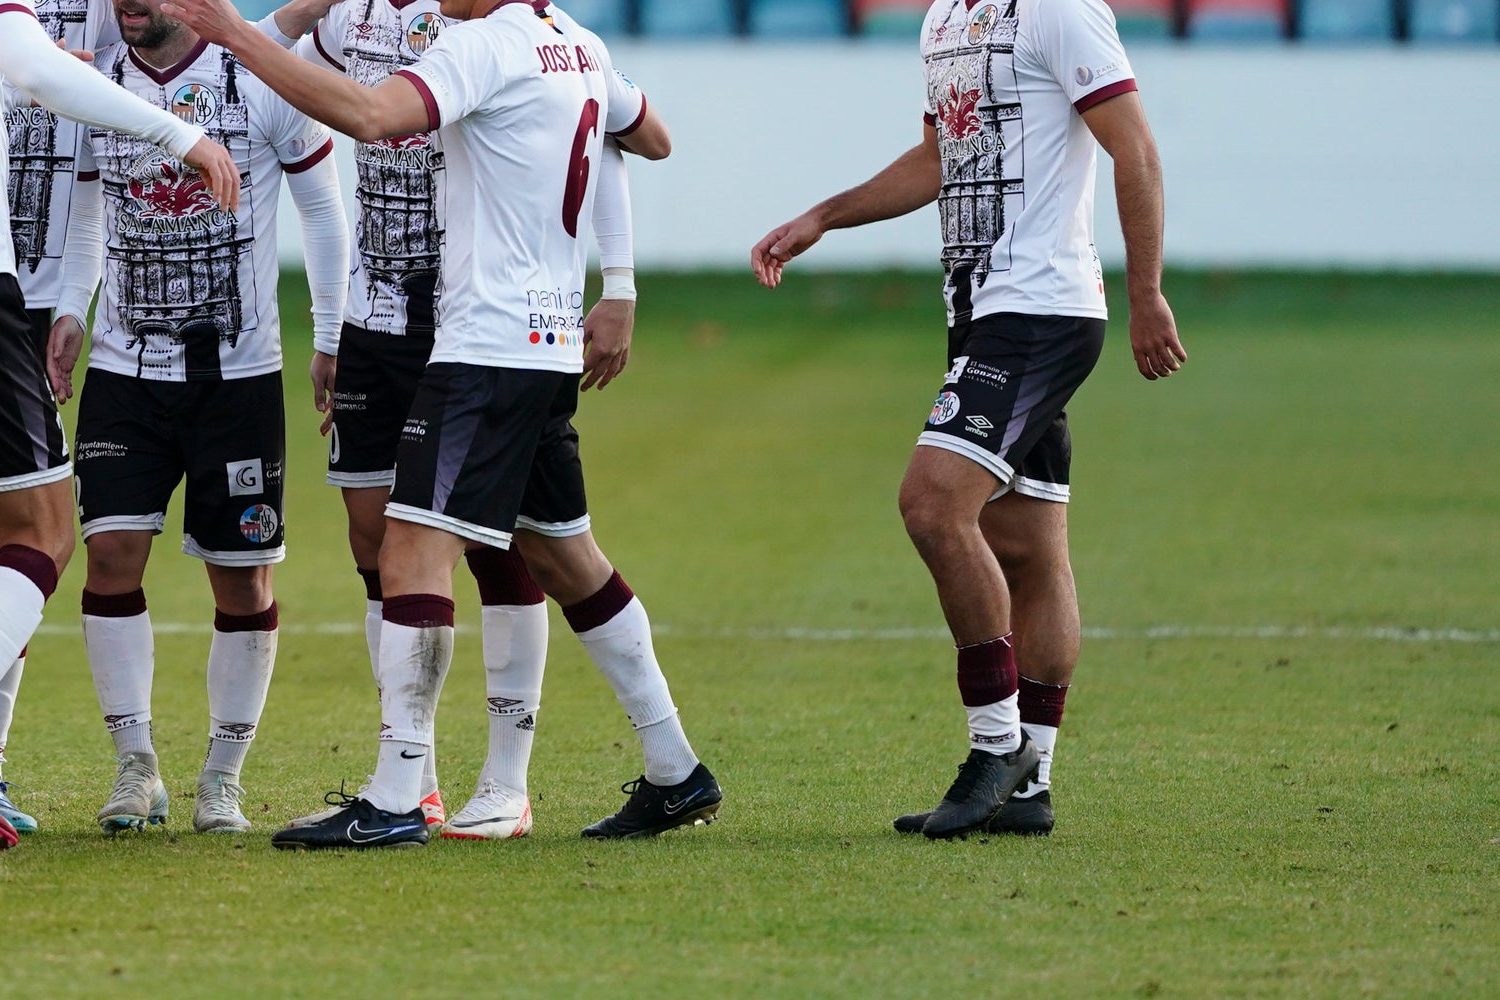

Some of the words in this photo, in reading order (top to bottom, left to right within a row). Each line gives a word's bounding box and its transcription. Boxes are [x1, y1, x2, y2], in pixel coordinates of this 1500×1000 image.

[536, 44, 576, 74] JOSE
[562, 98, 599, 239] 6
[119, 208, 239, 235] SALAMANCA
[527, 287, 563, 309] nani
[966, 367, 1007, 384] Gonzalo
[964, 425, 989, 438] umbro
